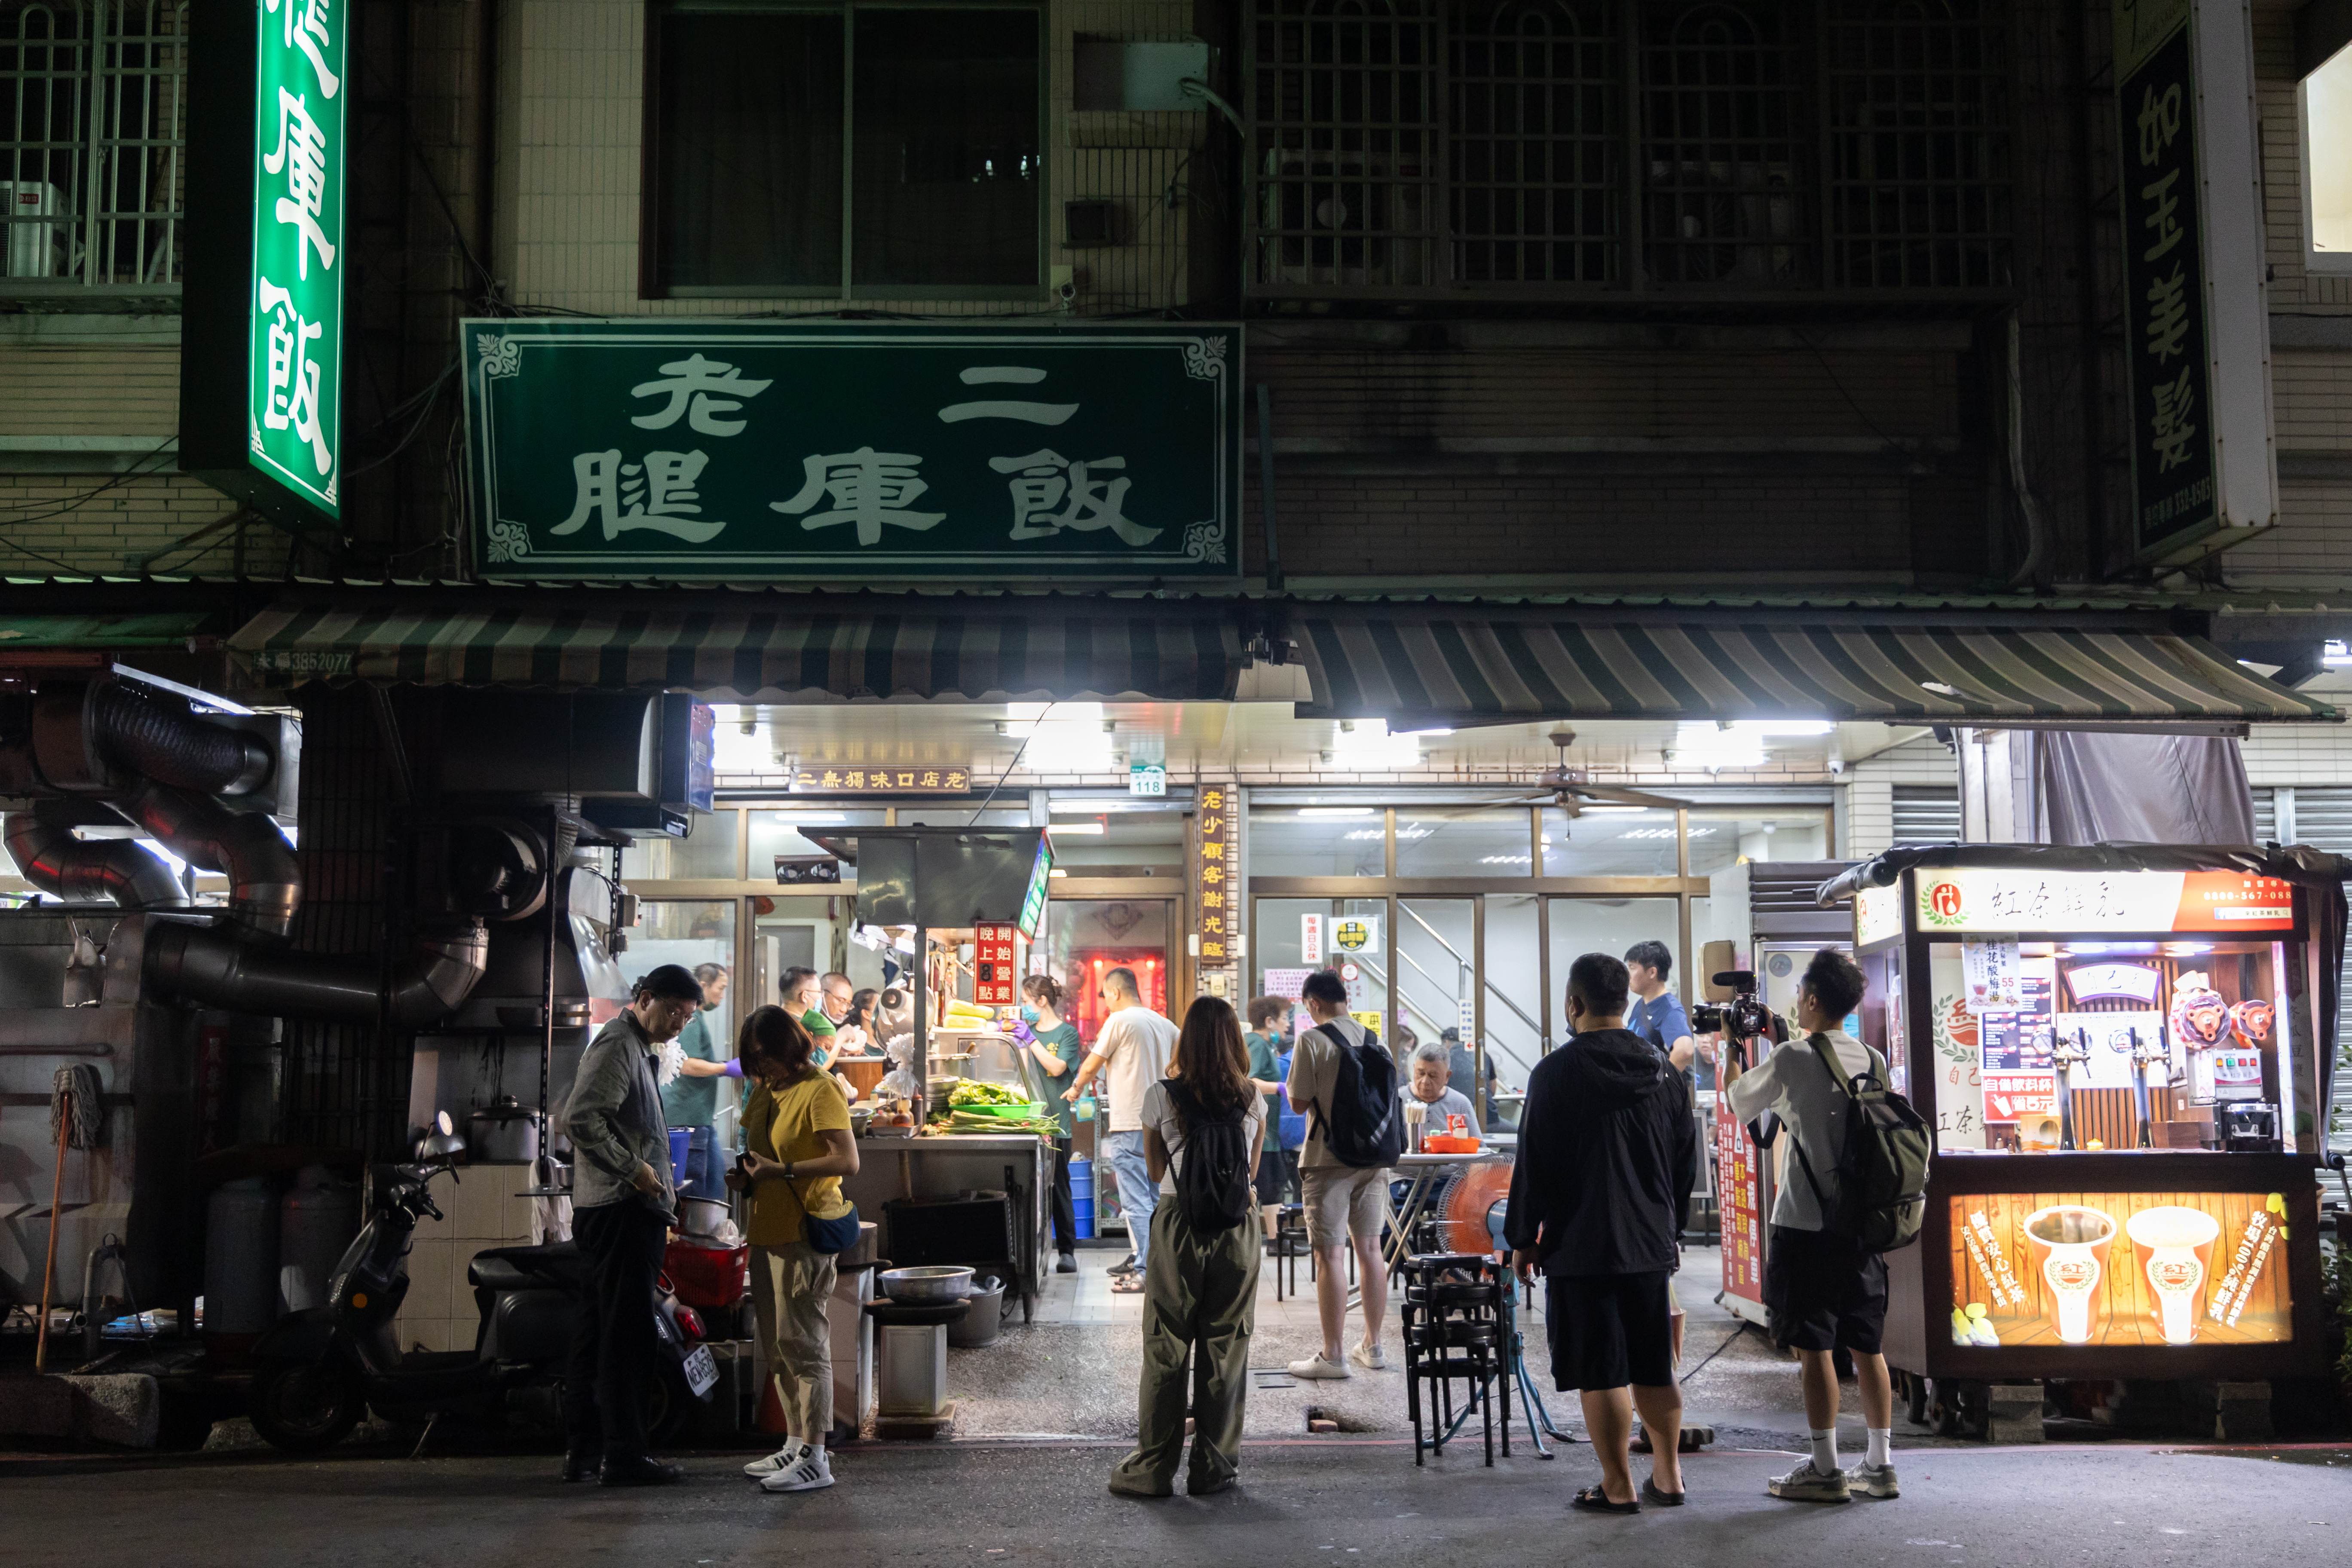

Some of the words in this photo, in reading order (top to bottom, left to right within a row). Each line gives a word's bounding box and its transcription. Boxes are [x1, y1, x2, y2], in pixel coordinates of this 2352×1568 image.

[2136, 82, 2196, 475] 如玉美髮
[550, 446, 1164, 546] 腿庫飯
[1136, 781, 1160, 793] 118
[1202, 791, 1224, 957] 老少顧客謝光臨
[996, 927, 1012, 1001] 開始營業
[1307, 916, 1317, 960] 每週日公休
[1984, 938, 2000, 1002] 桂花酸梅湯
[2002, 977, 2014, 987] 55
[1984, 1078, 2052, 1092] 自備飲料杯
[1970, 1210, 2025, 1304] 優質安心紅茶
[2209, 1210, 2268, 1321] 牧場100%純鮮乳
